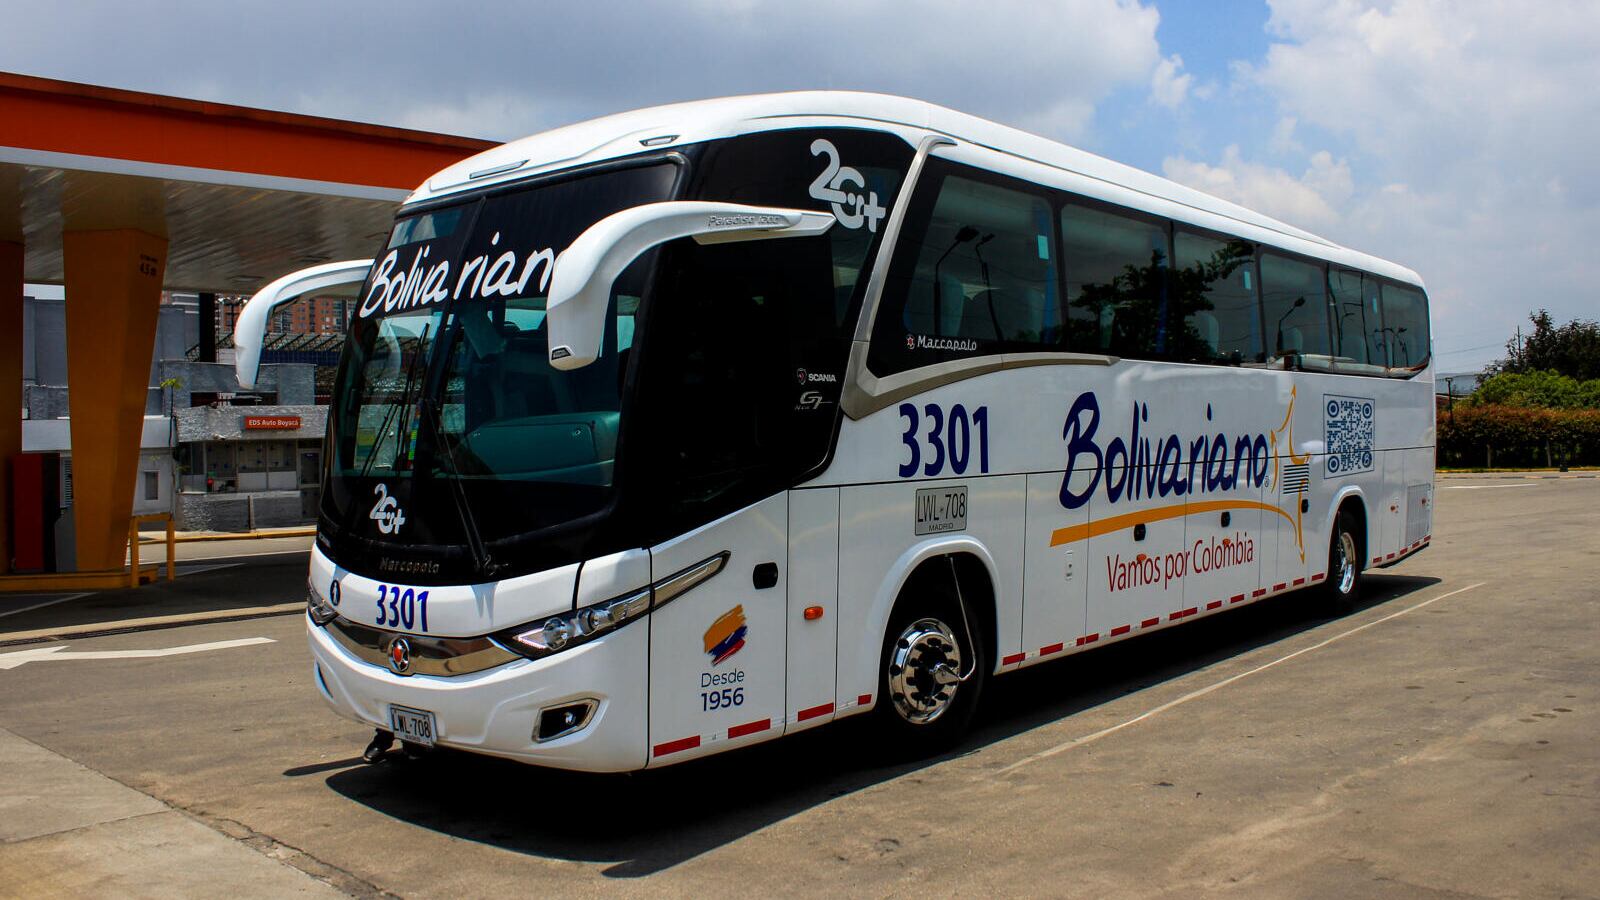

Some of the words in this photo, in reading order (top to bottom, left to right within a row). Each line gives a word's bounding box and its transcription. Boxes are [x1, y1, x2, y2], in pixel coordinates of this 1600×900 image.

[359, 232, 554, 318] Bolivarian
[917, 335, 977, 351] Marcopolo
[808, 373, 837, 382] SCANIA
[898, 403, 989, 478] 3301
[1059, 391, 1269, 509] Bolivariano
[928, 523, 954, 532] MADRID
[1106, 553, 1161, 592] Vamos
[1164, 548, 1191, 590] por
[1192, 531, 1254, 574] Colombia
[375, 584, 430, 632] 3301
[701, 668, 745, 688] Desde
[701, 687, 744, 712] 1956
